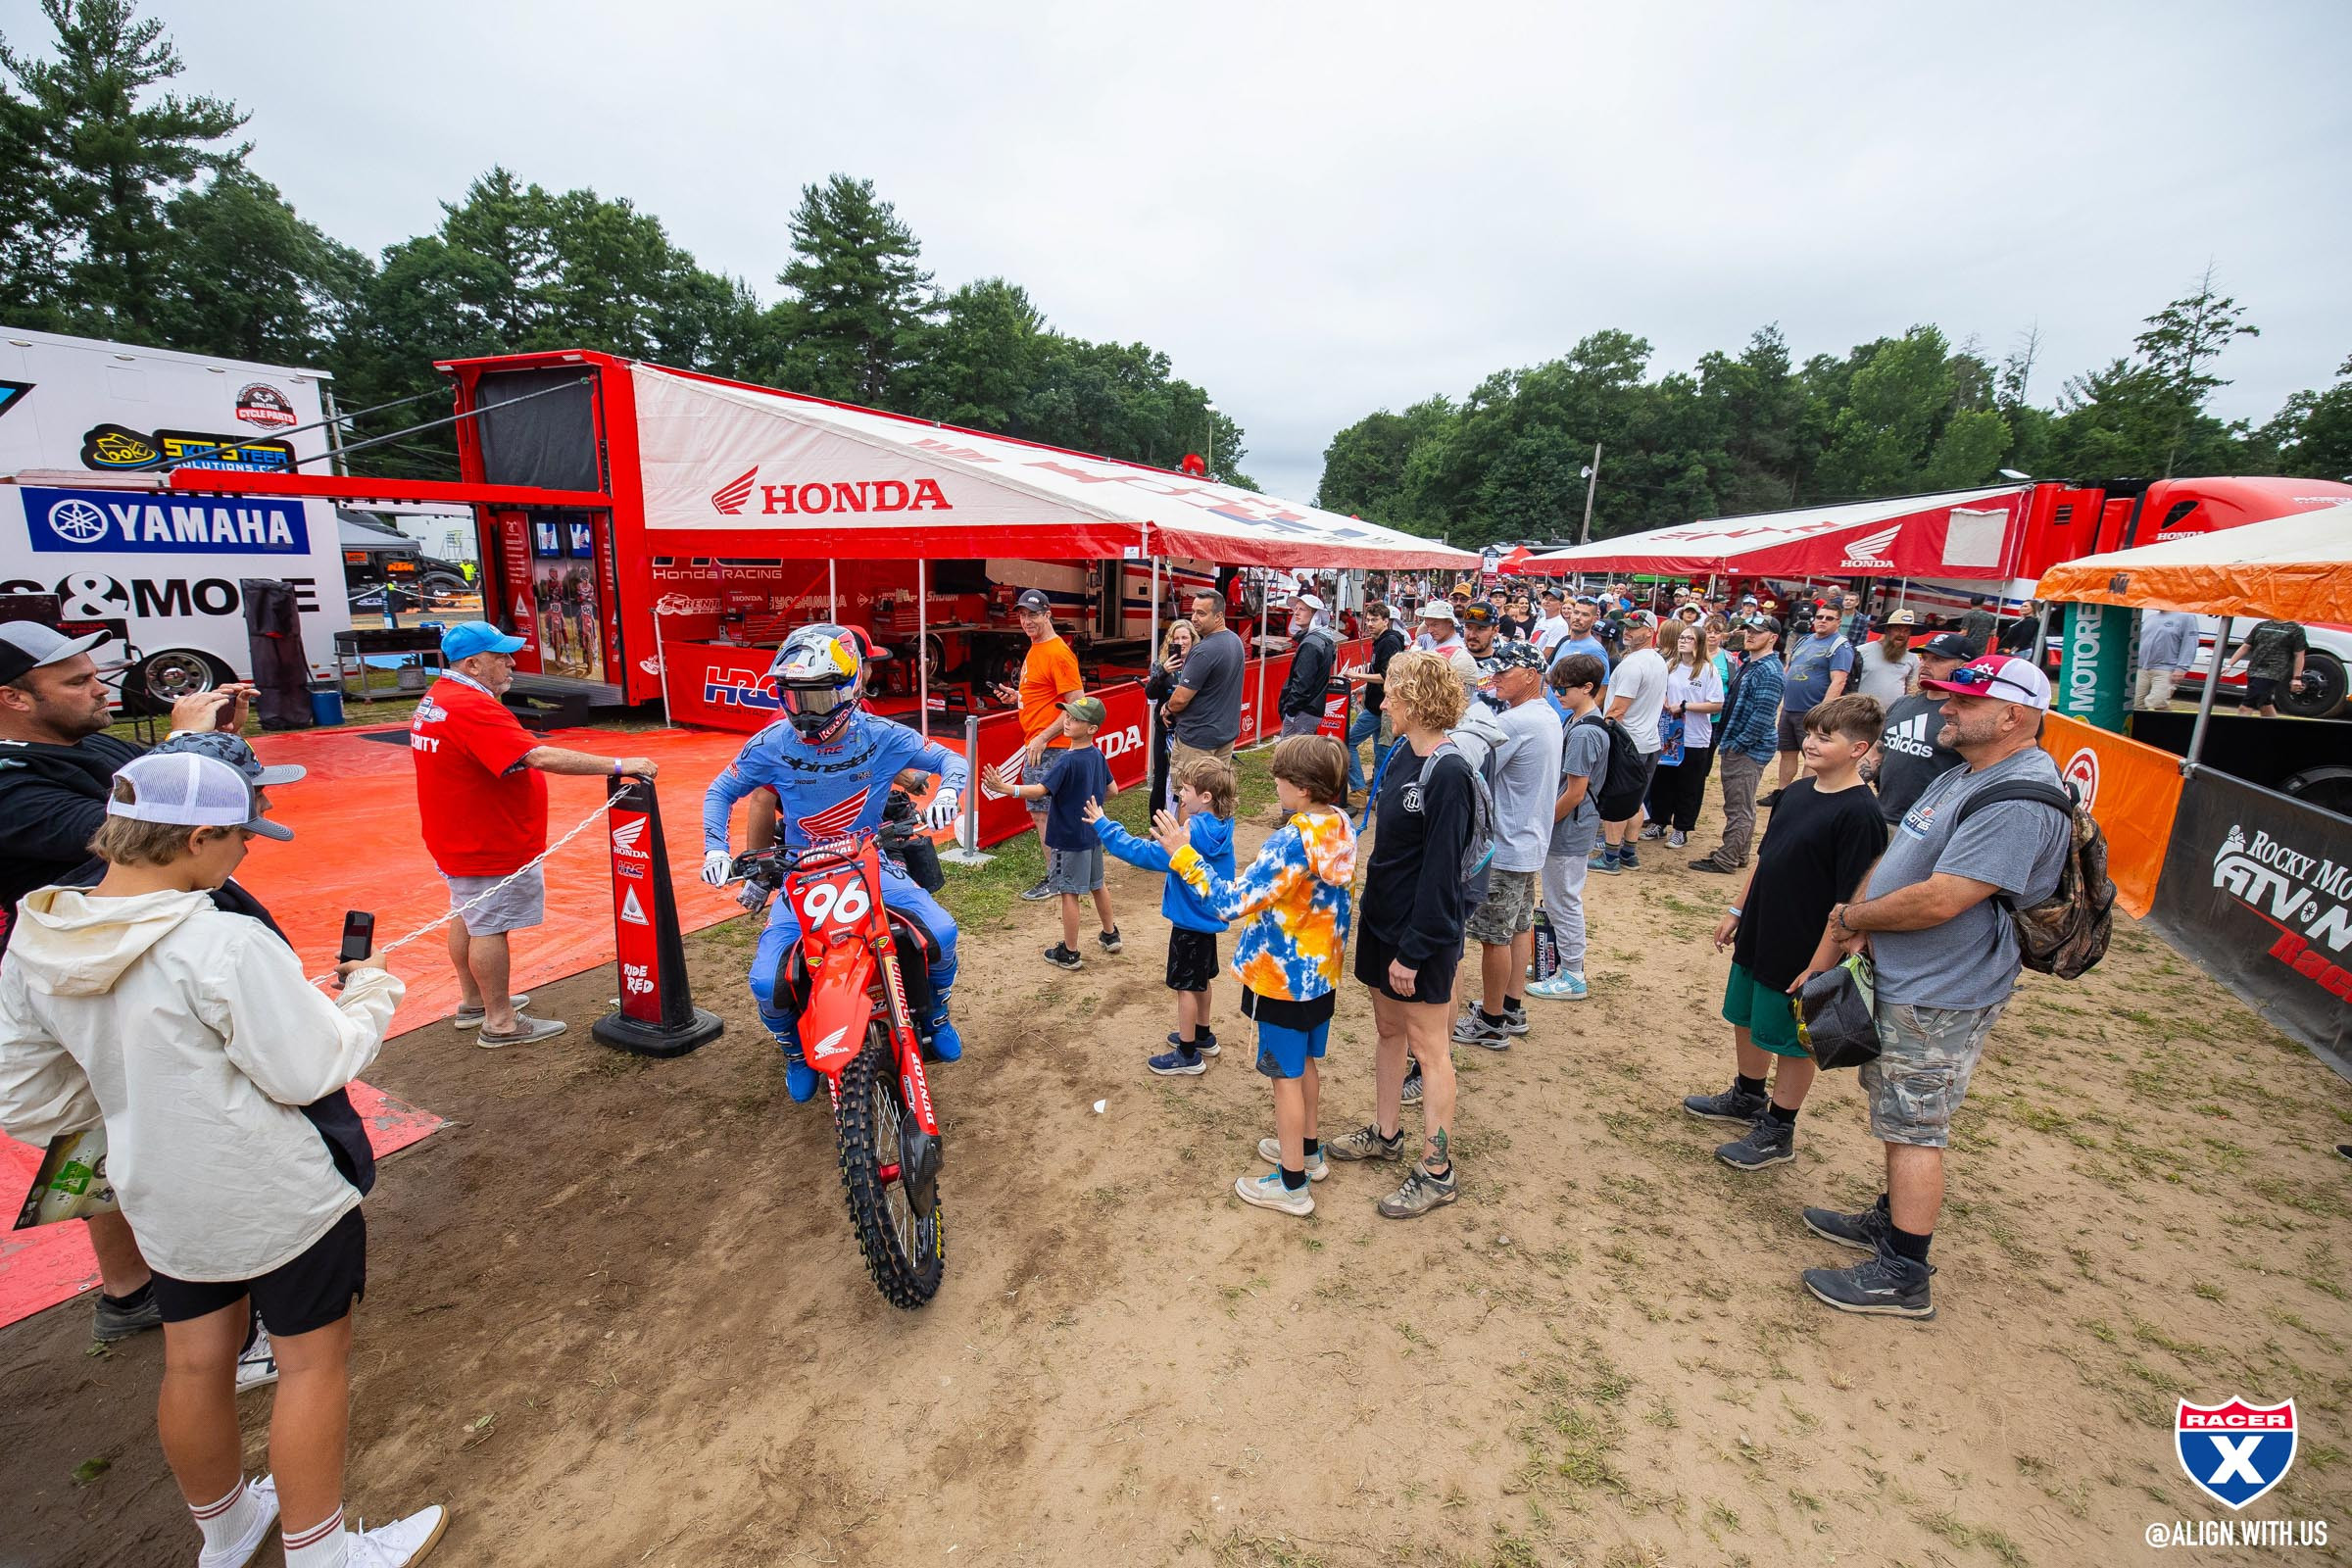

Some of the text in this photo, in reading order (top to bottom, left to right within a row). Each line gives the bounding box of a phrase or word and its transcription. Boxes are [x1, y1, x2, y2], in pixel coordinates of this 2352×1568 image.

[238, 408, 294, 423] CYCLE PARTS
[251, 401, 279, 411] ONLINE
[761, 478, 953, 514] HONDA
[109, 504, 294, 545] YAMAHA
[653, 569, 783, 580] Honda RACING
[1884, 734, 1934, 759] adidas
[781, 743, 878, 773] alpinestars
[612, 846, 650, 859] HONDA
[2246, 830, 2317, 881] ROCKY
[2213, 856, 2313, 921] ATV
[804, 875, 870, 932] 96
[828, 925, 854, 936] HONDA
[623, 962, 648, 977] RIDE
[627, 976, 655, 996] RED
[814, 1046, 851, 1060] HONDA
[910, 1052, 935, 1125] DUNLOP
